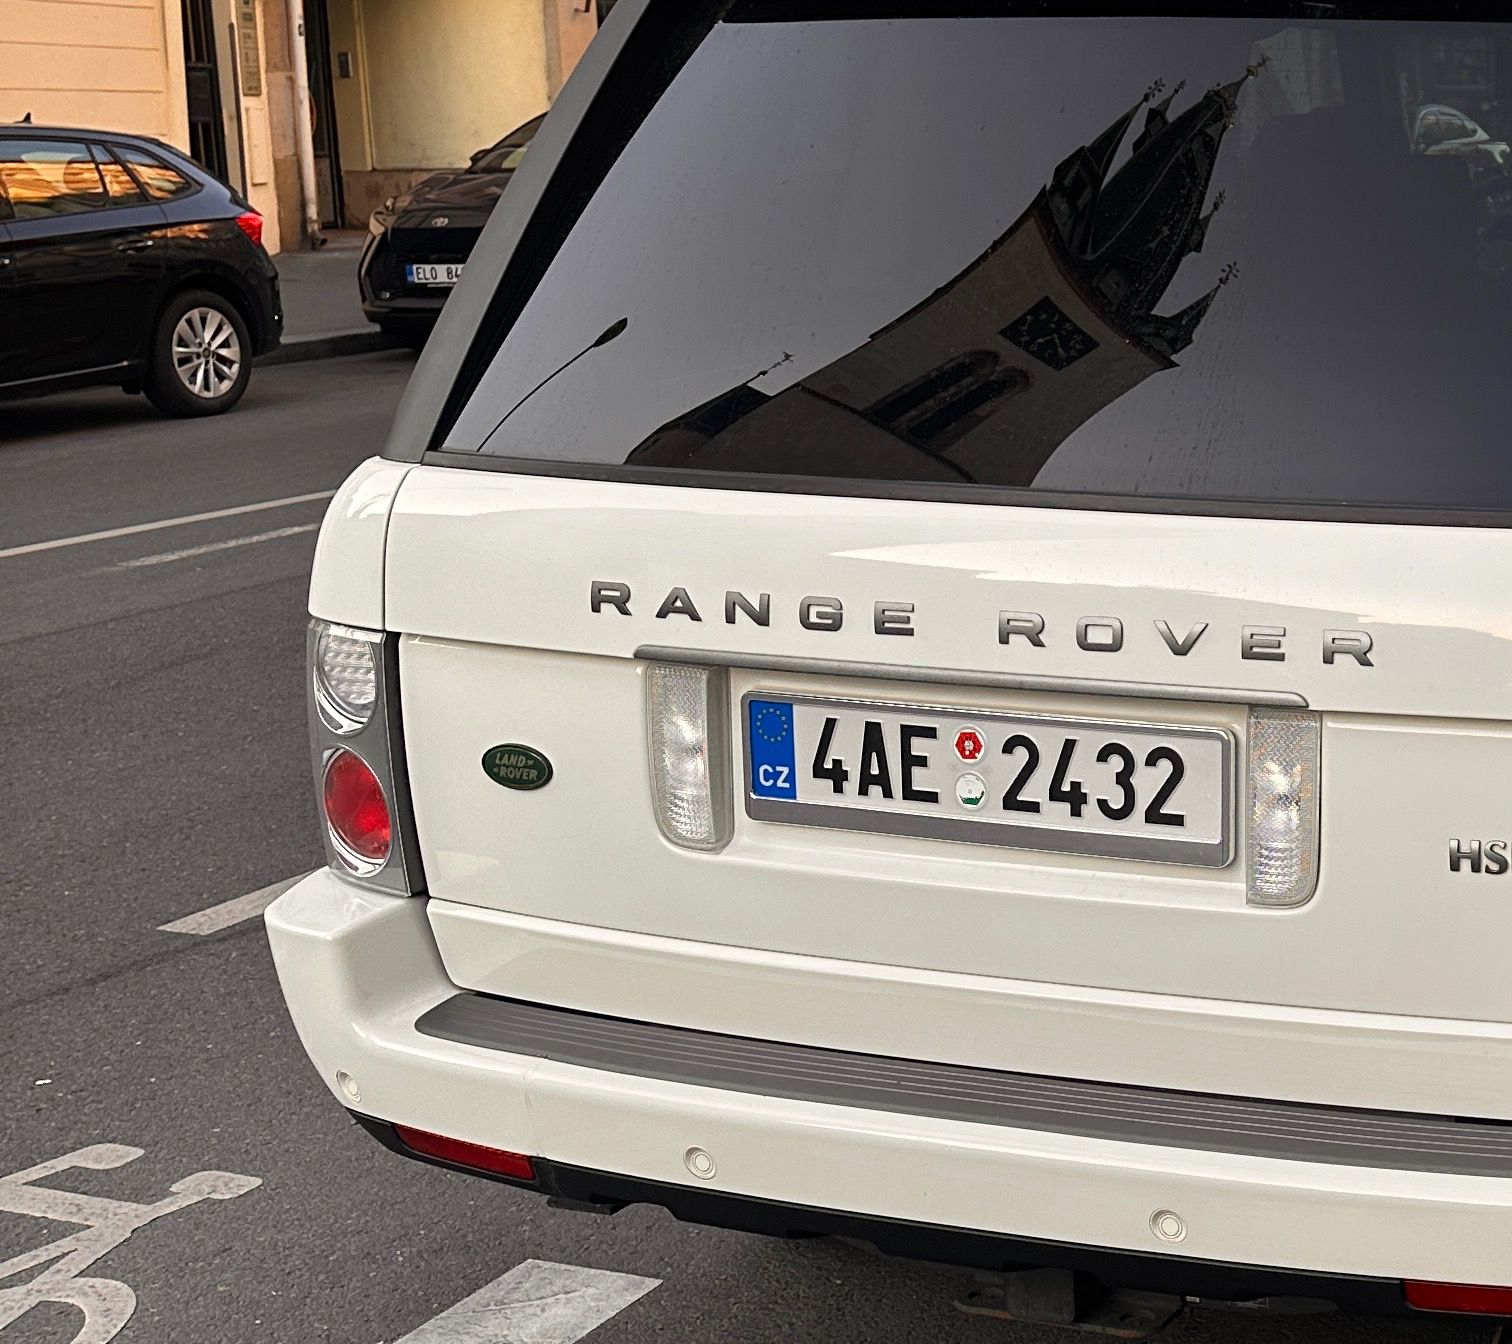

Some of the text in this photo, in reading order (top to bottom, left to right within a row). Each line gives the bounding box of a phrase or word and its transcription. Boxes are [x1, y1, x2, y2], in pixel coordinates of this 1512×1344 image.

[590, 580, 1374, 667] RANGE ROVER
[495, 752, 526, 767] LAND
[500, 765, 538, 781] ROVER
[759, 764, 790, 788] CZ
[812, 717, 1185, 827] 4AE 2432
